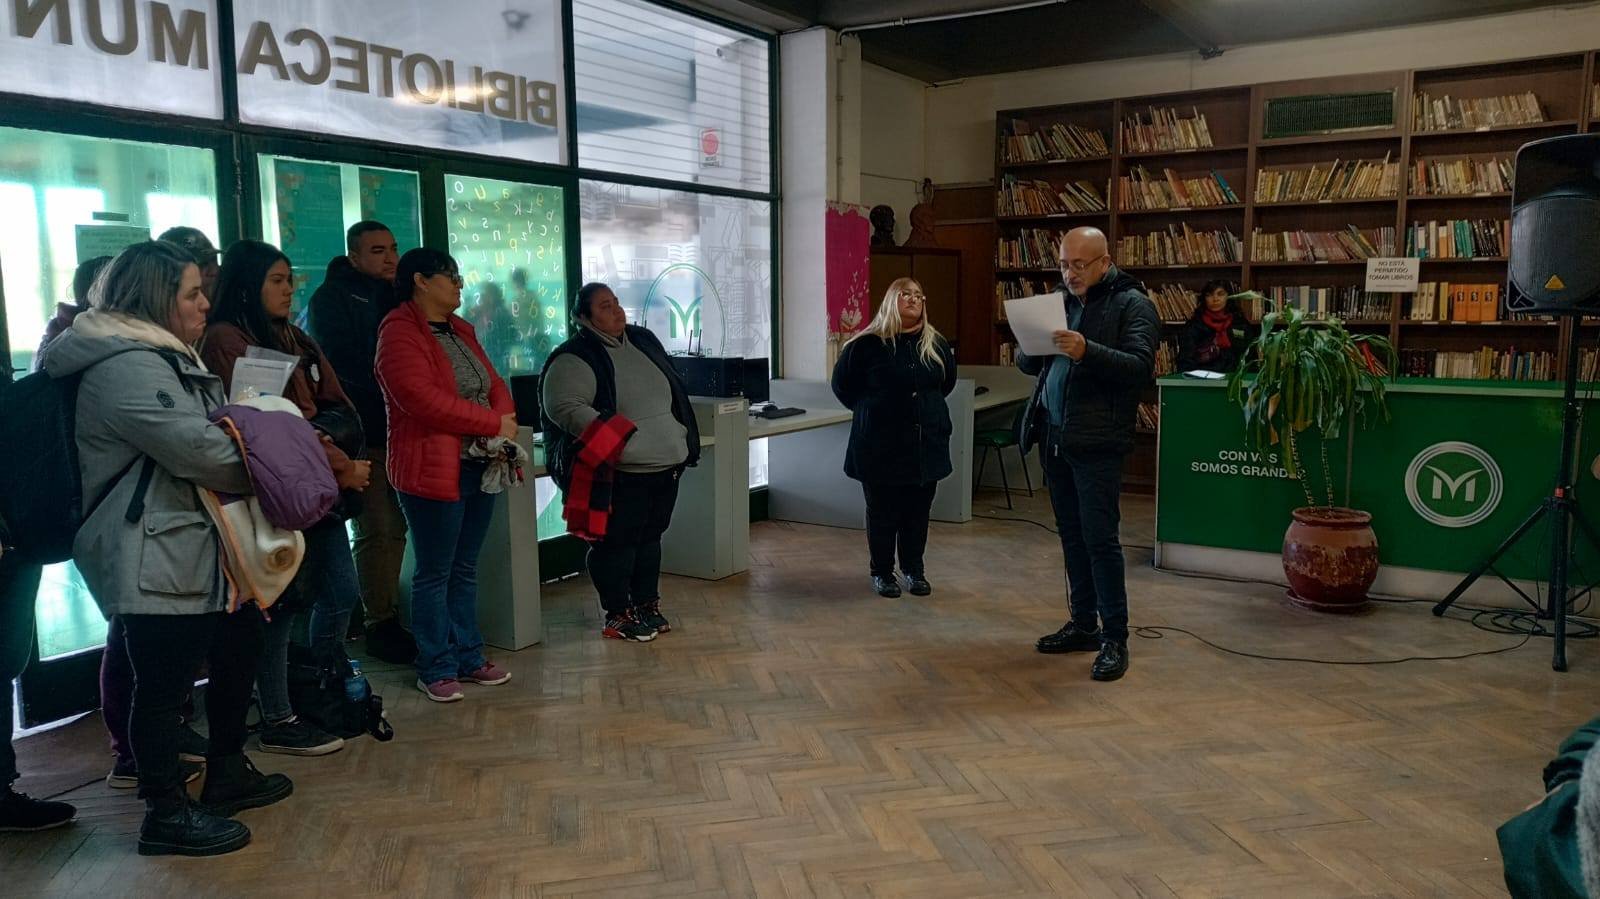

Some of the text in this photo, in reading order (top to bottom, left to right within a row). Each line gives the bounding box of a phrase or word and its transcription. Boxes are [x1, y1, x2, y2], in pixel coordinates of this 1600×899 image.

[1218, 450, 1278, 464] CON VS
[1191, 461, 1305, 480] SOMOS GRAND
